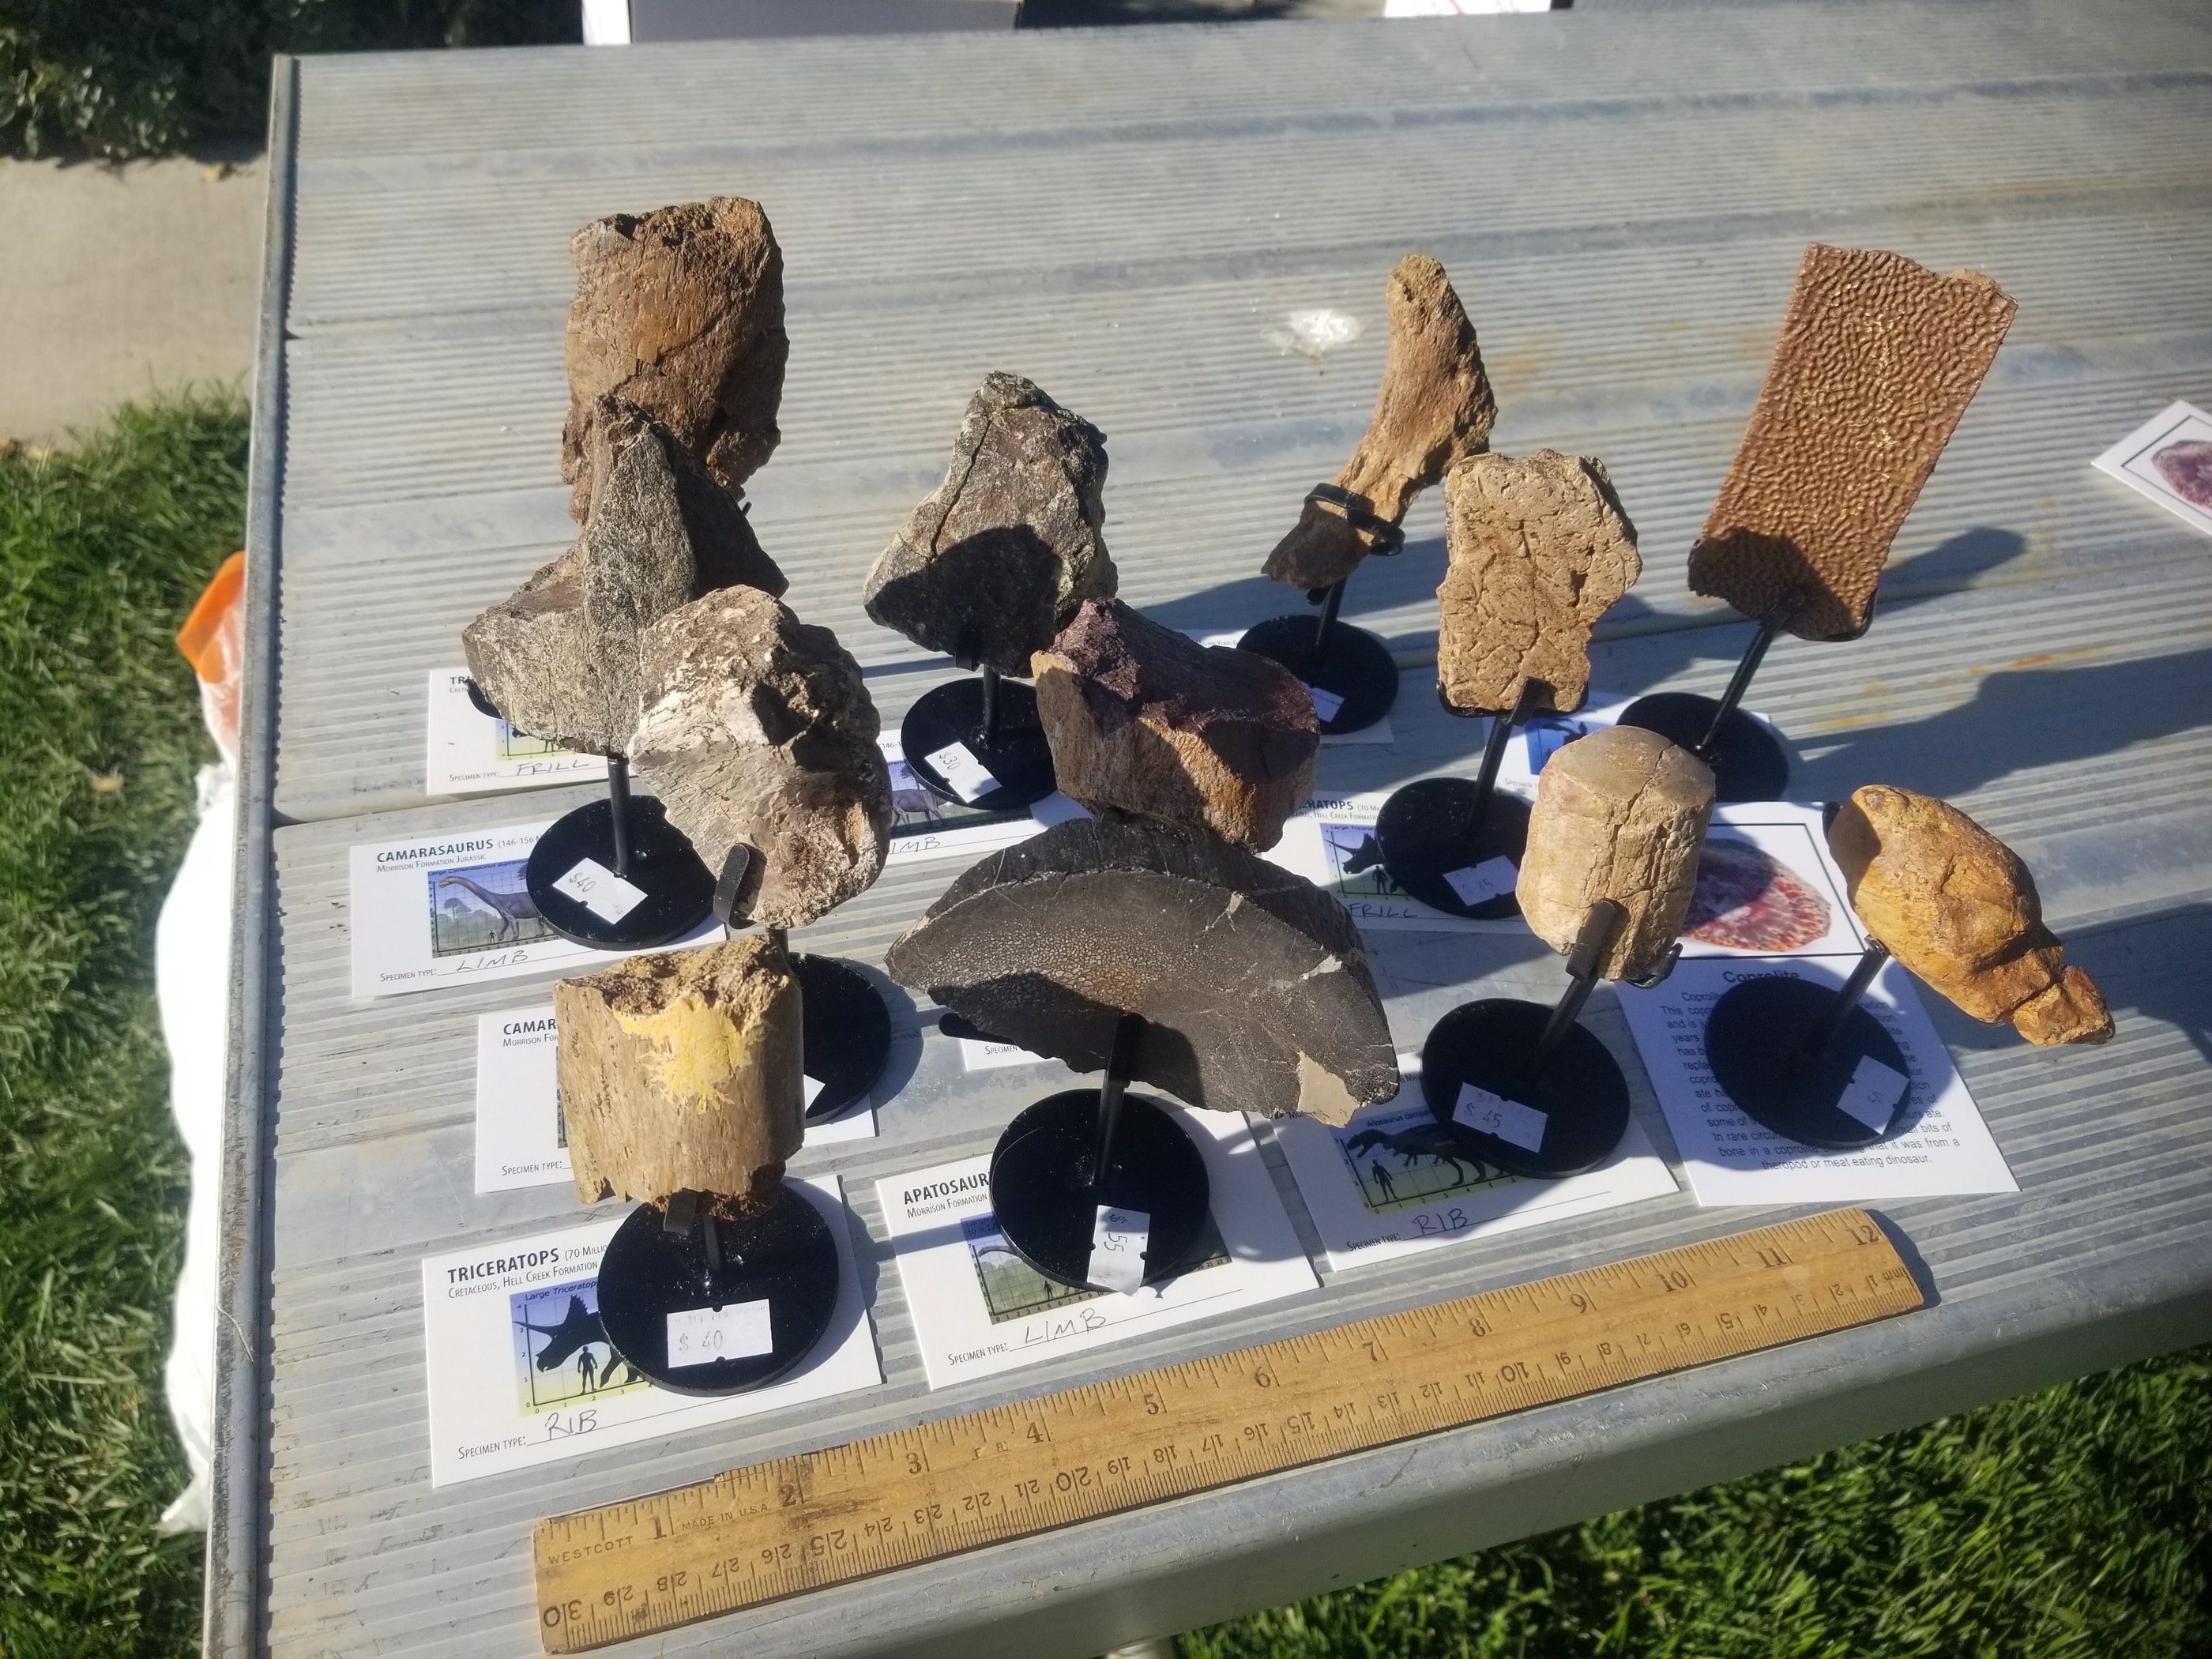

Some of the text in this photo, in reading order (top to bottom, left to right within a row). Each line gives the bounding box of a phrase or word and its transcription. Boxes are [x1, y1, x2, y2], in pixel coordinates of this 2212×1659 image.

[450, 773, 481, 782] SPECIMEN
[517, 759, 590, 777] FRILL
[377, 838, 495, 863] CAMARASAURUS
[498, 837, 535, 848] (146-156
[377, 863, 414, 873] MORRISON
[416, 857, 455, 869] FORMATION
[456, 853, 487, 863] JURASSIC
[456, 950, 529, 972] LIMB
[380, 968, 438, 983] SPECIMEN TYPE:
[1667, 1020, 1686, 1029] and
[502, 1036, 542, 1048] MORRISON
[1672, 1034, 1700, 1044] years
[985, 1044, 1018, 1055] SPECIMEN
[1676, 1048, 1697, 1056] has
[1695, 1089, 1712, 1098] ate
[1701, 1102, 1711, 1112] of
[1367, 1115, 1404, 1127] Allosaurus
[1706, 1119, 1736, 1127] some
[1737, 1116, 1748, 1127] of
[1925, 1109, 1945, 1118] ate.
[1712, 1132, 1724, 1142] In
[1726, 1132, 1748, 1141] rare
[1919, 1123, 1940, 1134] bits
[1941, 1122, 1953, 1132] of
[1717, 1146, 1746, 1157] bone
[1748, 1146, 1760, 1156] in
[1890, 1139, 1899, 1149] it
[1902, 1139, 1923, 1149] was
[1924, 1138, 1950, 1148] from
[1952, 1138, 1961, 1147] a
[502, 1161, 562, 1176] SPECIMEN TYPE:
[1761, 1154, 1932, 1172] theropod or meat eating dinosaur.
[904, 1172, 991, 1206] APATOSAUR
[907, 1193, 988, 1219] MORRISON FORMATION
[1412, 1208, 1469, 1236] RIB
[1346, 1232, 1401, 1252] SPECIMEN TYPE:
[447, 1247, 560, 1285] TRICERATOPS
[564, 1248, 581, 1262] (70
[448, 1260, 598, 1300] CRETACEOUS, HELL CREEK FORMATION
[525, 1288, 551, 1302] Large
[1796, 1292, 1807, 1306] 3
[1719, 1311, 1734, 1330] 5
[1758, 1304, 1770, 1317] 4
[1025, 1307, 1107, 1345] LIMB
[1680, 1321, 1692, 1335] 6
[679, 1330, 724, 1353] $ 40
[1601, 1341, 1613, 1356] 8
[1642, 1332, 1653, 1345] 7
[947, 1341, 1009, 1366] SPECIMEN TYPE:
[1558, 1352, 1572, 1366] 9
[1464, 1371, 1487, 1387] 11
[1501, 1361, 1530, 1382] 10
[653, 1515, 667, 1540] 1
[908, 1451, 922, 1474] 3
[1026, 1421, 1044, 1444] 4
[1142, 1393, 1161, 1416] 5
[1255, 1366, 1272, 1388] 6
[1362, 1341, 1379, 1363] 7
[1469, 1317, 1486, 1337] 8
[1570, 1293, 1588, 1315] 9
[1657, 1270, 1689, 1294] 10
[1756, 1247, 1787, 1269] 11
[1845, 1224, 1879, 1247] 12
[1420, 1381, 1444, 1398] 12
[1377, 1391, 1401, 1409] 13
[1333, 1401, 1356, 1420] 14
[544, 1409, 597, 1441] RIB
[1243, 1423, 1270, 1442] 16
[1287, 1410, 1316, 1435] 15
[458, 1435, 526, 1460] SPECIMEN TYPE:
[1202, 1433, 1225, 1453] 17
[1153, 1444, 1179, 1464] 18
[1107, 1455, 1132, 1475] 19
[1014, 1477, 1041, 1498] 21
[1055, 1465, 1093, 1492] 20
[961, 1492, 992, 1511] 22
[682, 1503, 771, 1531] MADE IN U.S.A.
[913, 1503, 944, 1525] 23
[863, 1516, 894, 1538] 24
[547, 1535, 633, 1565] WESTCOTT
[809, 1528, 848, 1557] 25
[760, 1543, 792, 1565] 26
[710, 1556, 741, 1579] 27
[656, 1570, 688, 1593] 28
[603, 1583, 634, 1607] 29
[543, 1598, 583, 1628] 30
